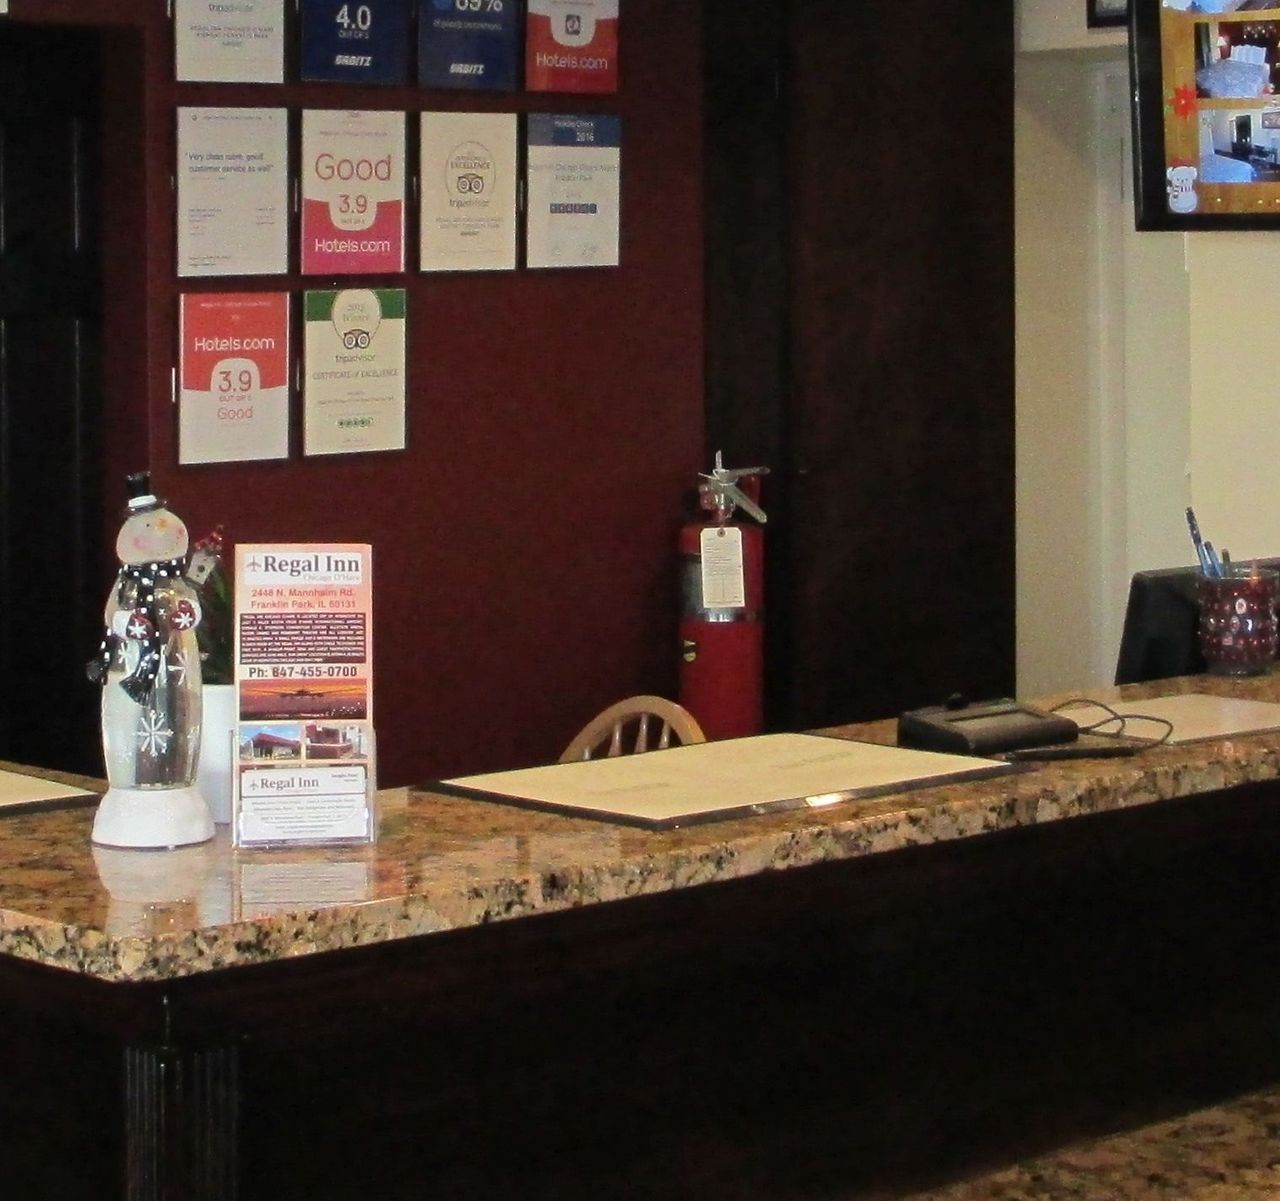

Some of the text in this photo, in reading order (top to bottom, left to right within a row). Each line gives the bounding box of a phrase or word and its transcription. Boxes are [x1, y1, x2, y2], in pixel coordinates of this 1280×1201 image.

[336, 4, 371, 30] 4.0
[536, 52, 608, 70] Hotels.com
[315, 153, 392, 181] Good
[339, 194, 368, 214] 3.9
[315, 238, 390, 252] Hotels.com
[195, 337, 275, 351] Hotels.com
[218, 370, 252, 392] 3.9
[217, 406, 254, 419] Good
[264, 555, 359, 577] Regal Inn
[251, 589, 273, 597] 2448
[249, 666, 357, 677] Ph: 847-455-0700
[260, 777, 295, 790] Regal
[299, 777, 319, 787] Inn
